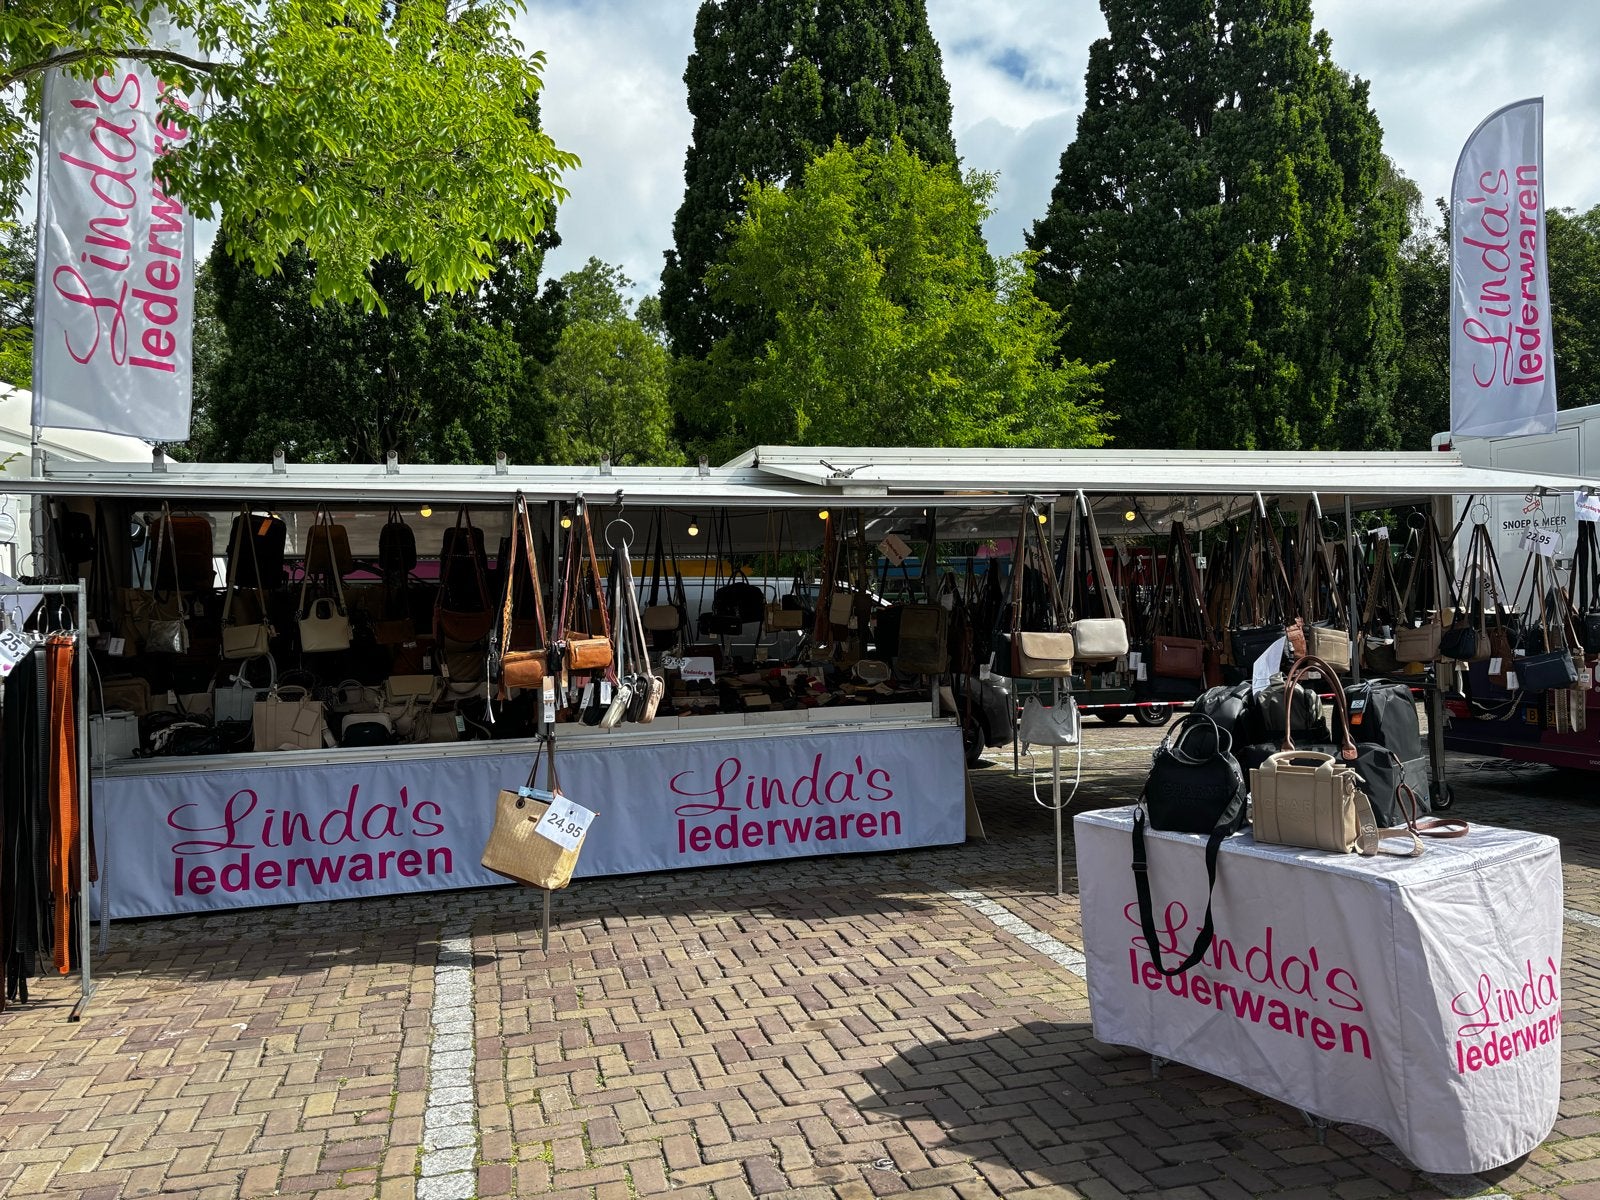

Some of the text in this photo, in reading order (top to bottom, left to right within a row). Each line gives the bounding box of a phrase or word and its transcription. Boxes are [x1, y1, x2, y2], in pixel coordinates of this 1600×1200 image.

[52, 69, 142, 366] Linda's
[128, 79, 190, 373] lederwre
[1463, 169, 1513, 387] Linda's
[1513, 165, 1544, 384] lederwaren
[1502, 519, 1531, 530] SNOEP
[1541, 516, 1567, 527] MEER
[1525, 531, 1551, 545] 22,95
[167, 783, 444, 855] Linda's
[669, 753, 894, 817] Linda's
[547, 812, 583, 838] 24,95
[678, 811, 902, 853] lederwaren
[174, 847, 453, 896] lederwaren
[1129, 948, 1372, 1060] lederwaren
[1451, 956, 1559, 1037] Linda'
